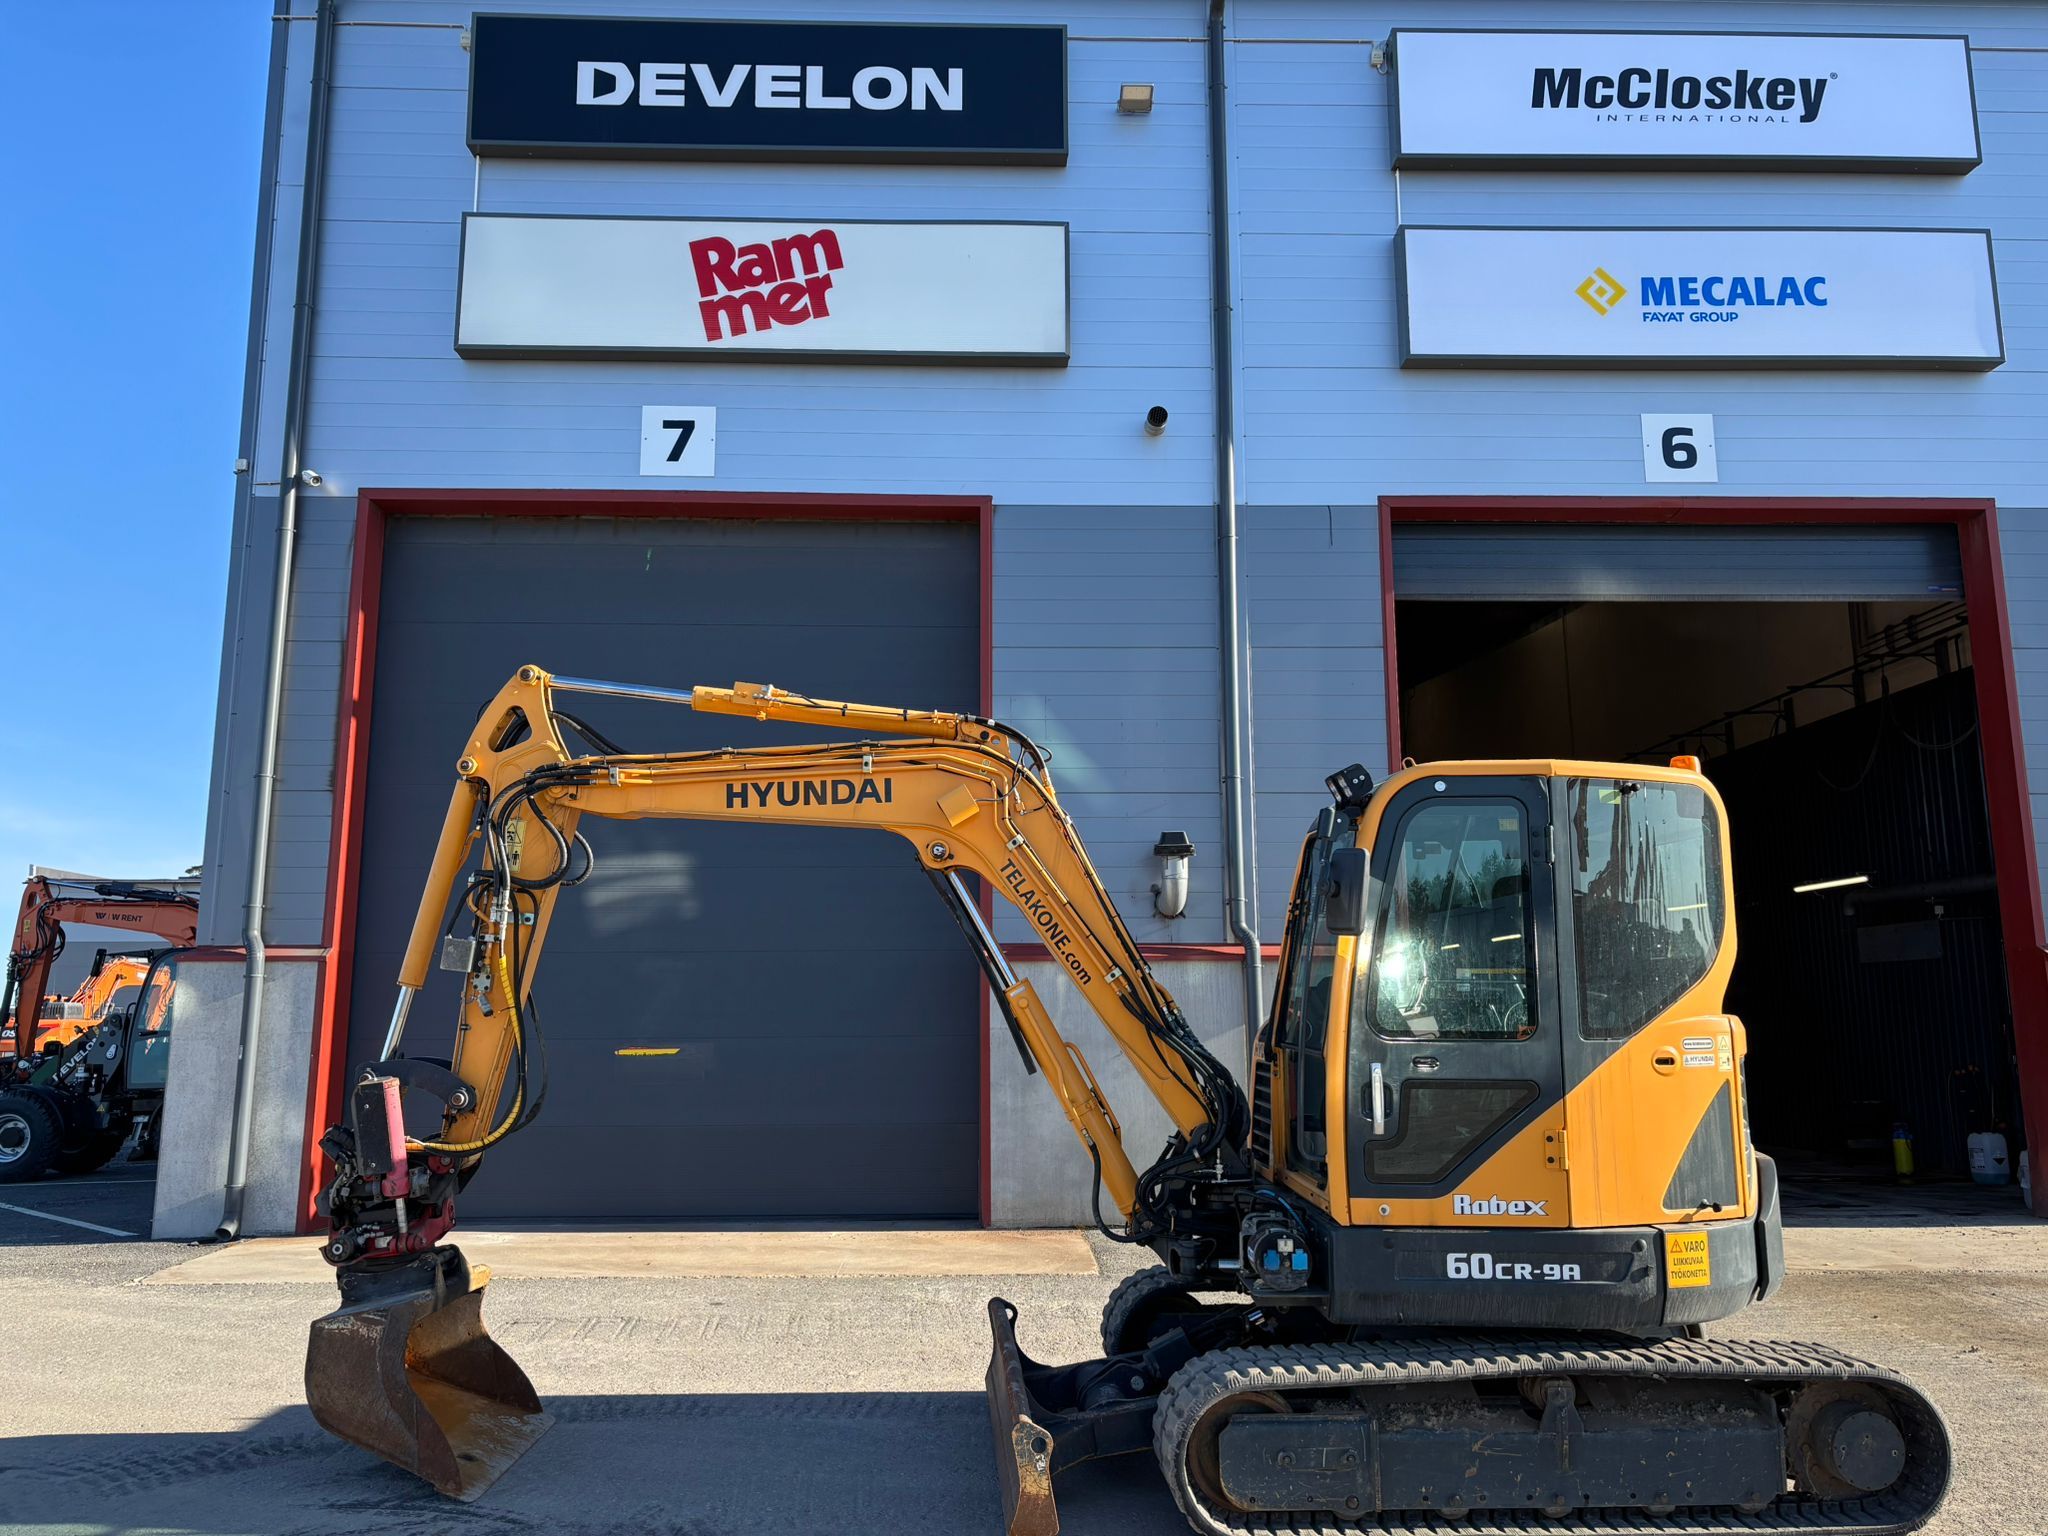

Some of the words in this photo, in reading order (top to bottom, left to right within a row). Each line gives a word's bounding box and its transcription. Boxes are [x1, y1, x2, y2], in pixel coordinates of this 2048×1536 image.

[576, 61, 963, 111] DEVELON
[1531, 67, 1828, 123] McCloskey
[1596, 114, 1790, 123] INTERNATIONAL
[1640, 276, 1828, 307] MECALAC
[1643, 312, 1685, 322] FAYAT
[1689, 312, 1739, 322] GROUP
[662, 420, 696, 462] 7
[1660, 427, 1698, 469] 6
[725, 777, 893, 809] HYUNDAI
[121, 914, 144, 922] RENT
[1000, 858, 1092, 986] TELAKONE.com
[1452, 1194, 1549, 1216] Robex
[1683, 1240, 1706, 1252] VARO
[1446, 1252, 1581, 1280] 60CR-9A
[1673, 1256, 1704, 1266] LIIKKUVAA
